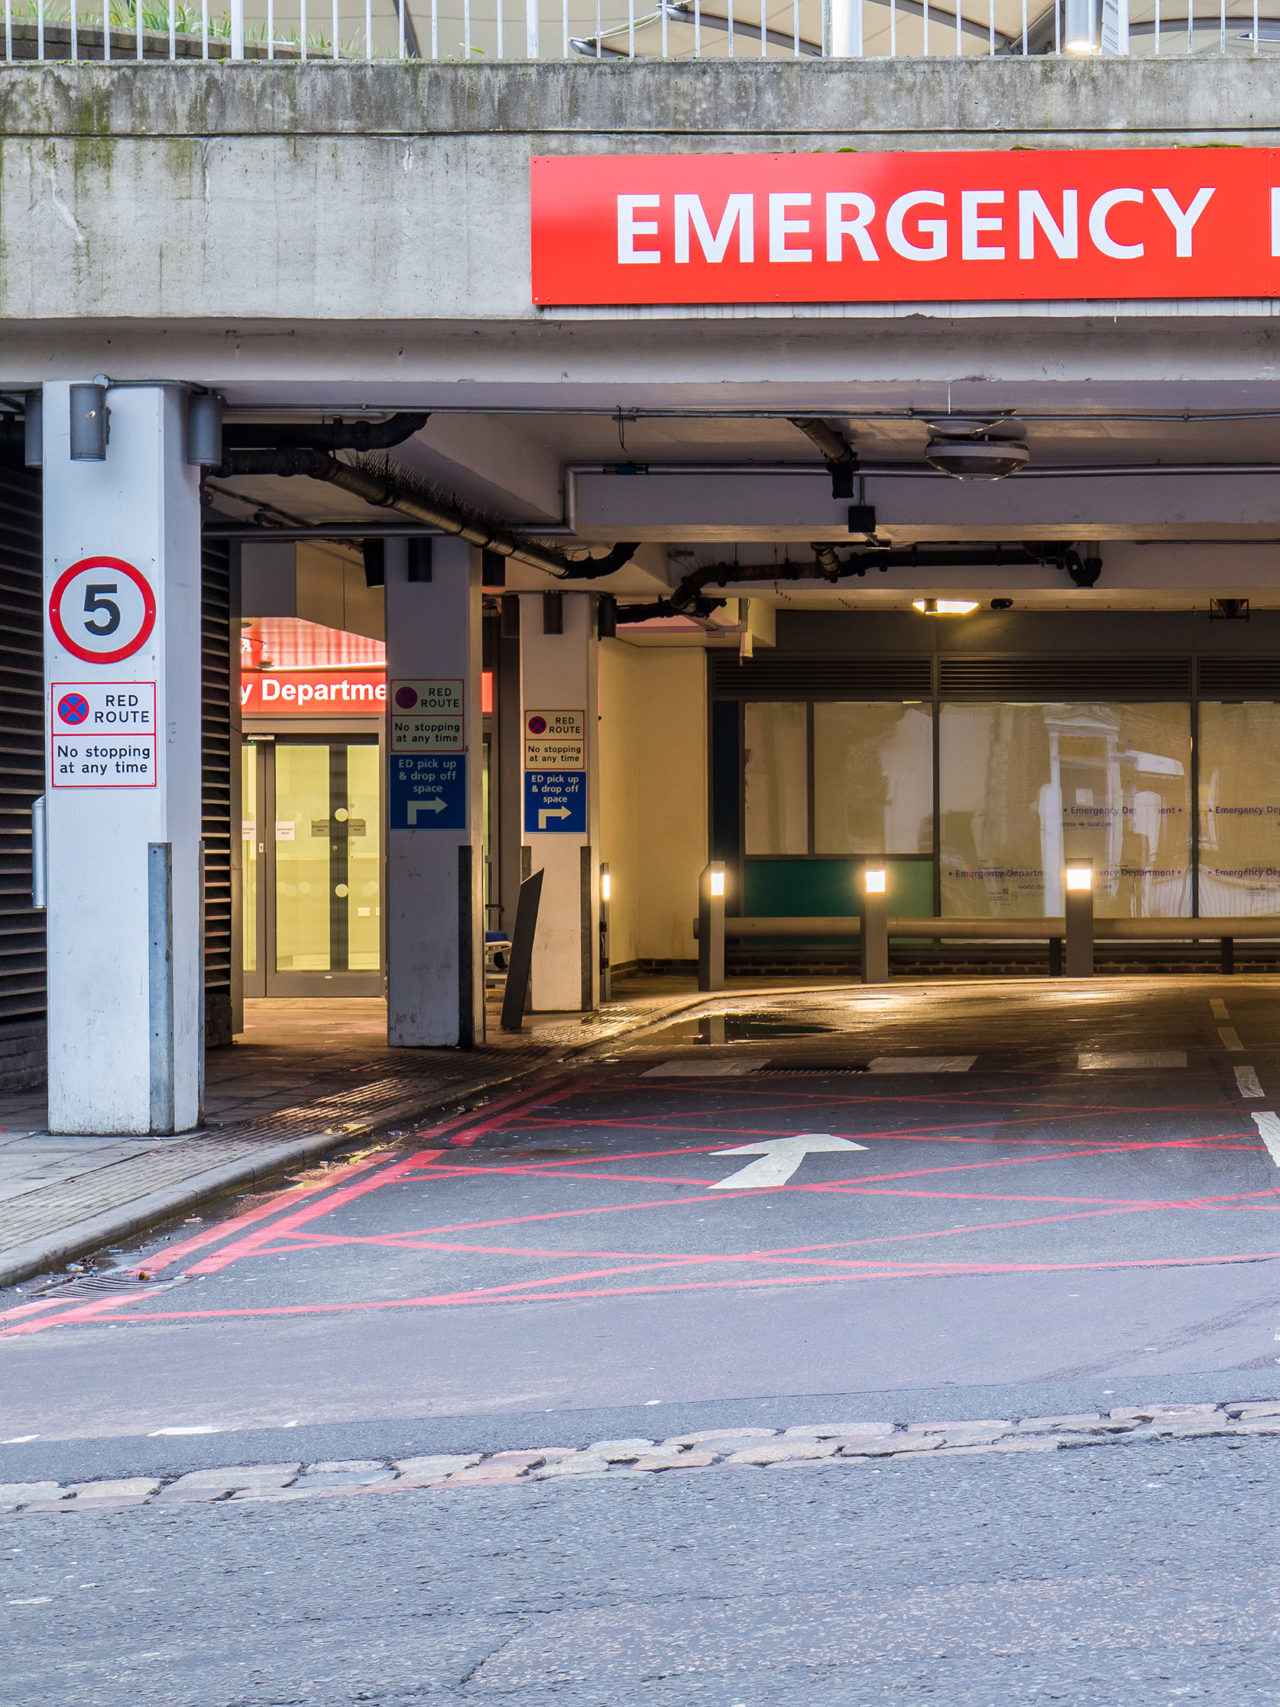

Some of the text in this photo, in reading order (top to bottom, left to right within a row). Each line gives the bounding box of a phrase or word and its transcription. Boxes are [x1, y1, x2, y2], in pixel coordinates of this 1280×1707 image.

[617, 187, 1216, 265] EMERGENCY
[83, 583, 121, 636] 5
[262, 679, 386, 705] Departme
[429, 688, 452, 696] RED
[105, 694, 138, 707] RED
[421, 699, 459, 708] ROUTE
[94, 711, 149, 723] ROUTE
[395, 723, 460, 733] No stopping
[549, 726, 581, 734] ROUTE
[396, 734, 458, 744] at any time
[57, 745, 150, 759] No stopping
[60, 761, 148, 776] at any time
[398, 758, 456, 770] ED pick up
[398, 771, 457, 782] & drop off
[547, 774, 565, 784] pick
[567, 776, 579, 784] up
[413, 785, 443, 795] space
[531, 784, 579, 794] & drop off
[543, 796, 568, 804] space
[1070, 807, 1175, 816] Emergency Deent
[1215, 806, 1264, 816] Emergency
[1007, 869, 1045, 878] Departm
[1121, 868, 1175, 877] Department
[1215, 868, 1264, 878] Emergency
